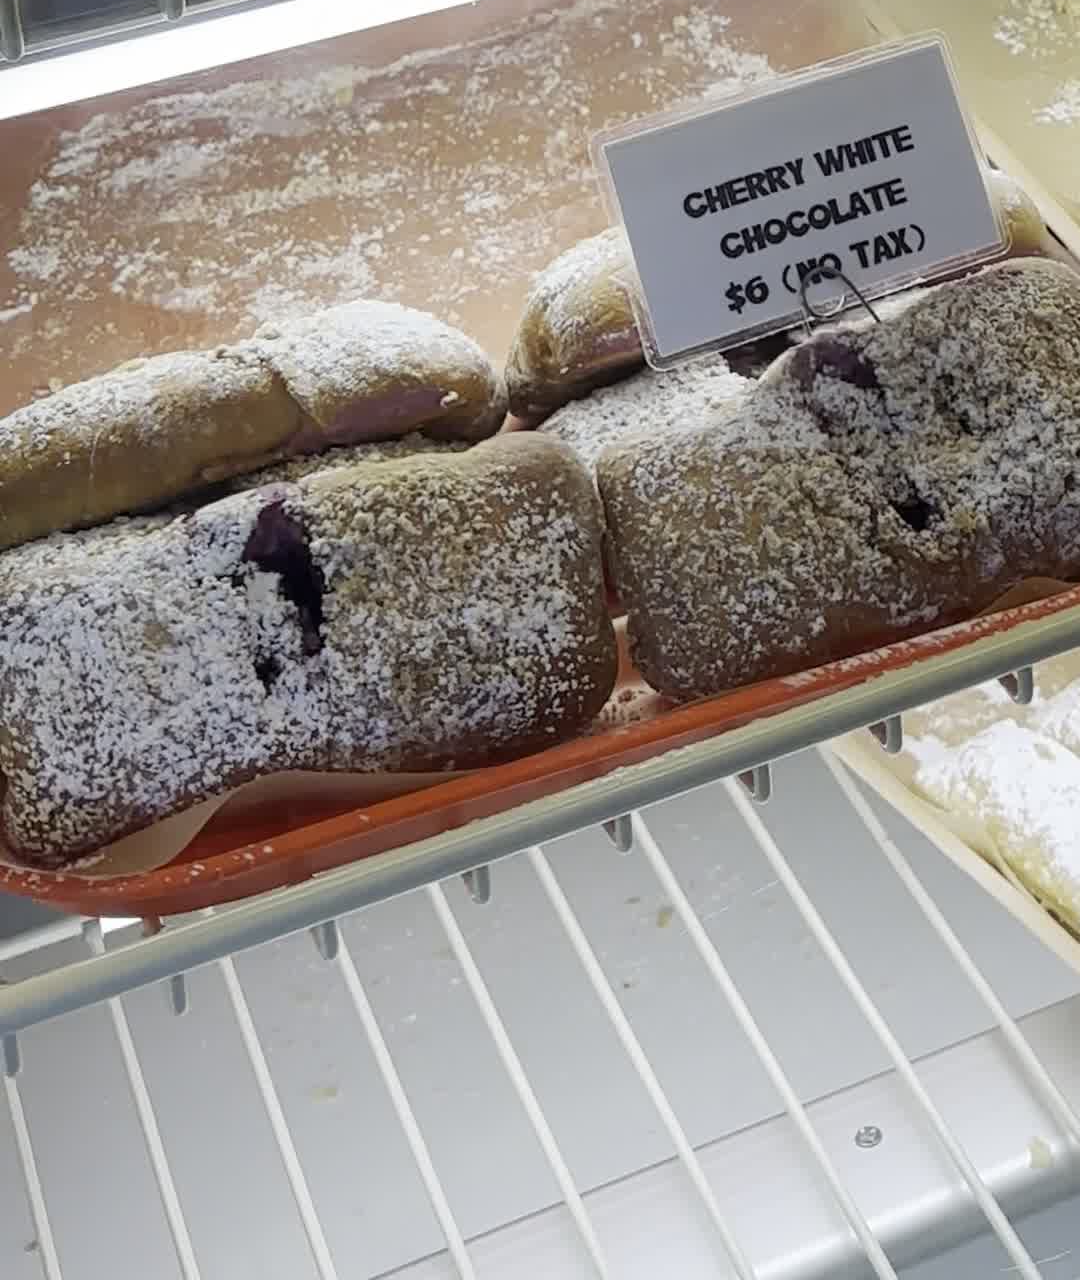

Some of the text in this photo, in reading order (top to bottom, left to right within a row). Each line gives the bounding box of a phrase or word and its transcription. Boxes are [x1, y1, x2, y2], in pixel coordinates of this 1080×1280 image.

[683, 124, 915, 219] CHERRY WHITE
[719, 177, 908, 259] CHOCOLATE
[724, 224, 926, 314] $6 (NO TAX)
